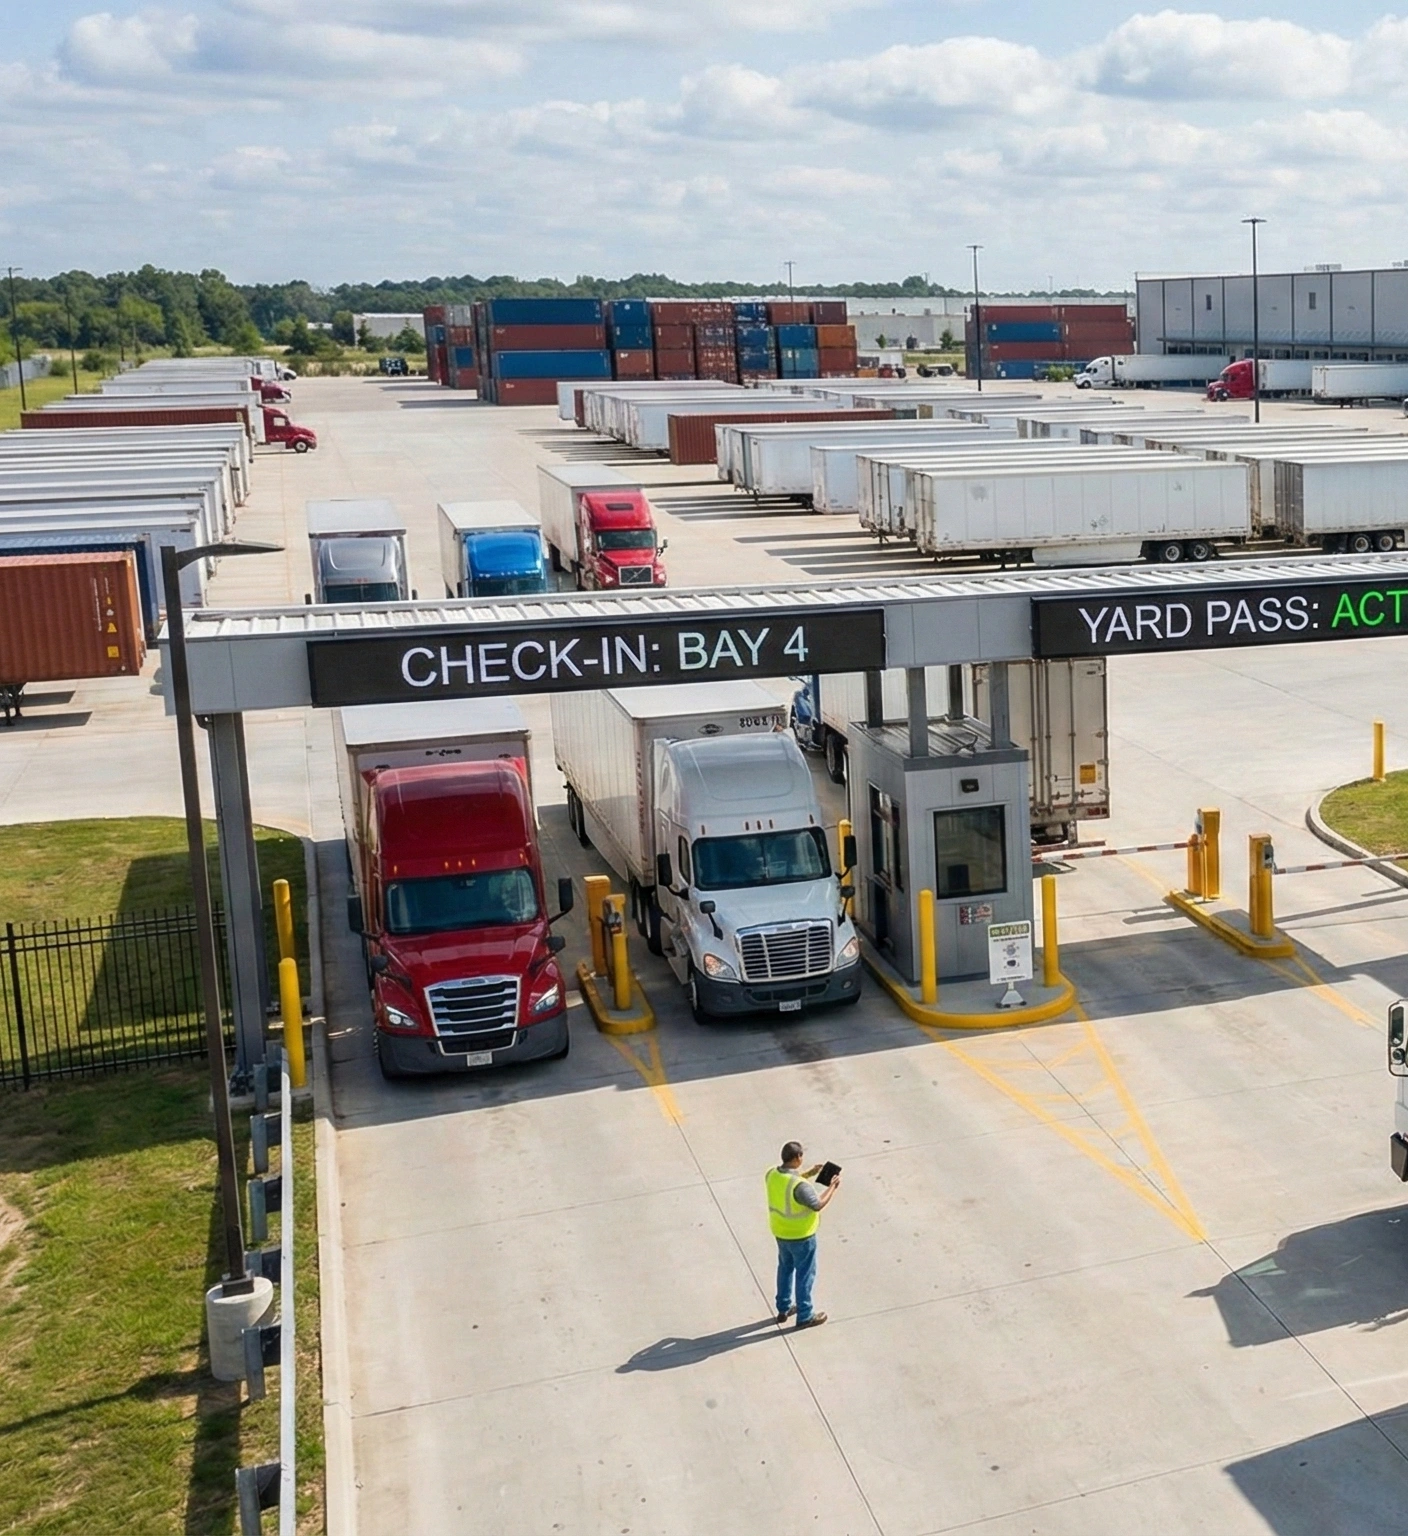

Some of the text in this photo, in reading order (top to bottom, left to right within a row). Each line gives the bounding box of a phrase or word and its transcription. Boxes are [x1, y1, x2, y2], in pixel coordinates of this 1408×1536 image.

[1078, 603, 1192, 644] YARD
[1206, 596, 1319, 636] PASS:
[401, 625, 809, 687] CHECK-IN: BAY 4
